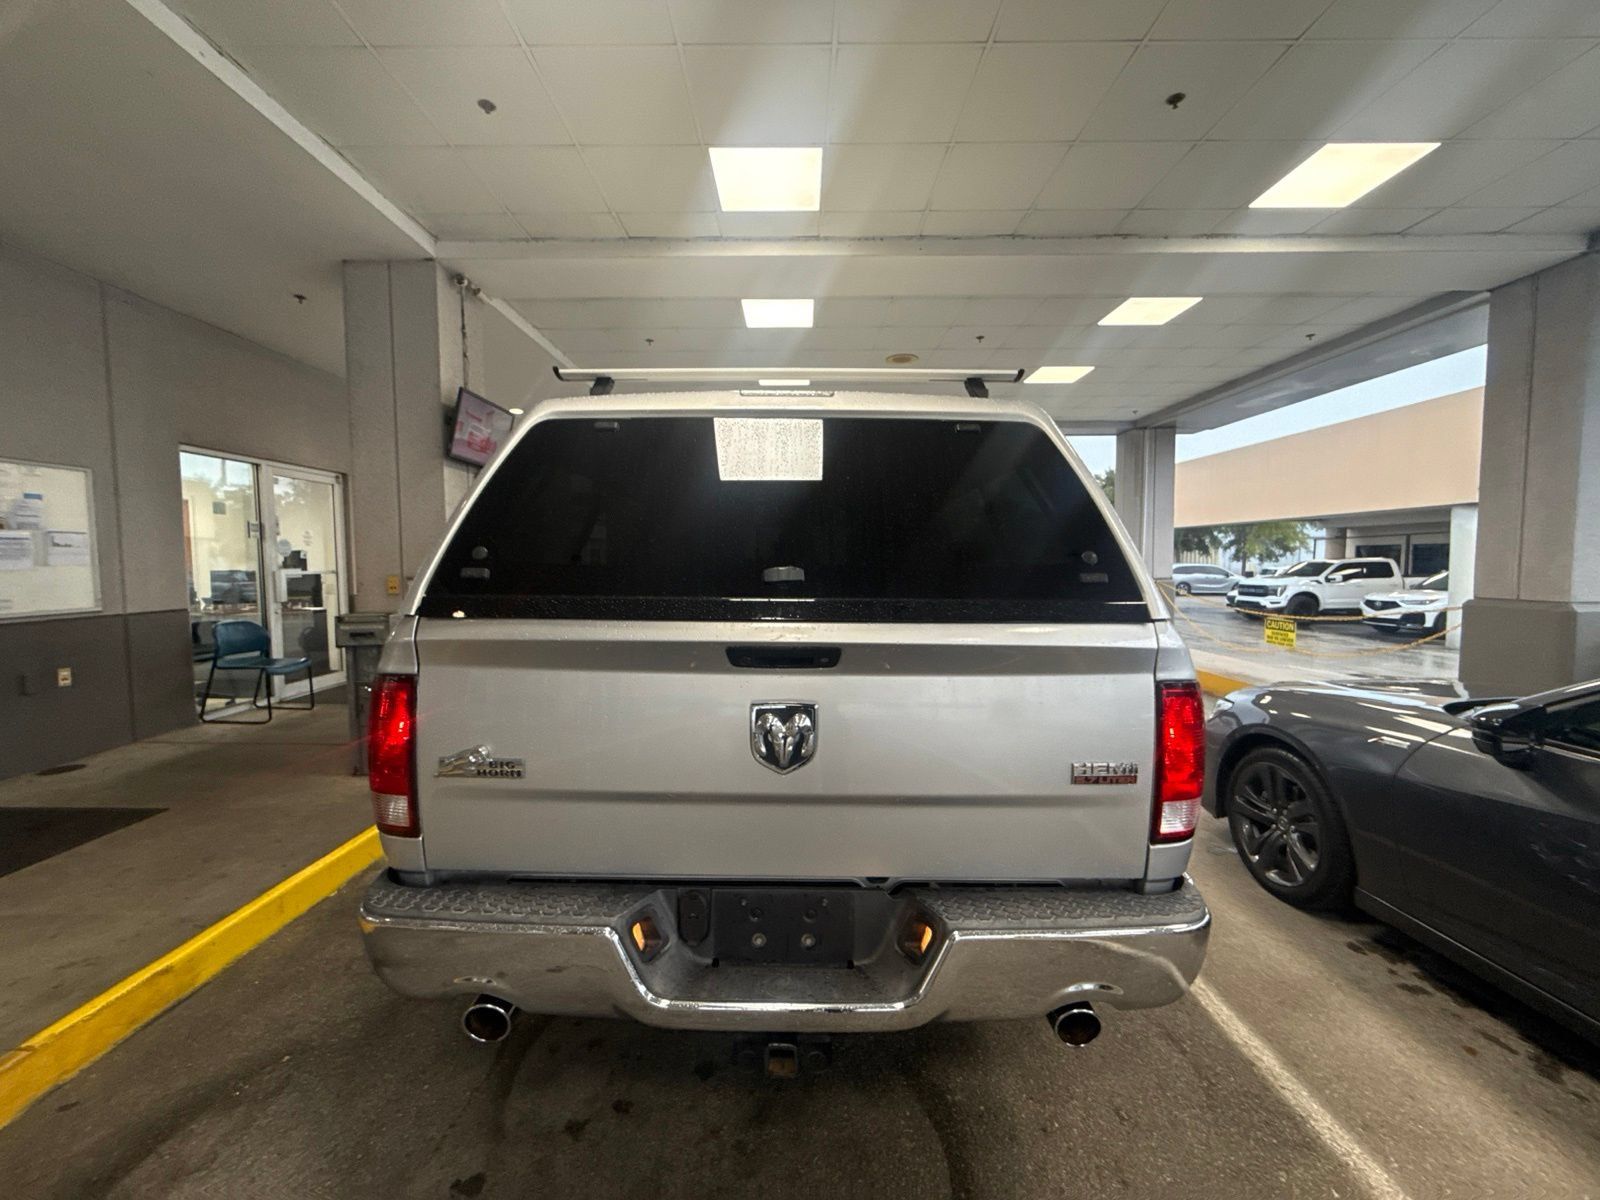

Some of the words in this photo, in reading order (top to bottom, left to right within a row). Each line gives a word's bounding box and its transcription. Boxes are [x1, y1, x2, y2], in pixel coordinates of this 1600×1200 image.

[1266, 620, 1294, 631] CAUTION
[489, 761, 515, 769] BIG
[477, 769, 522, 777] HORN
